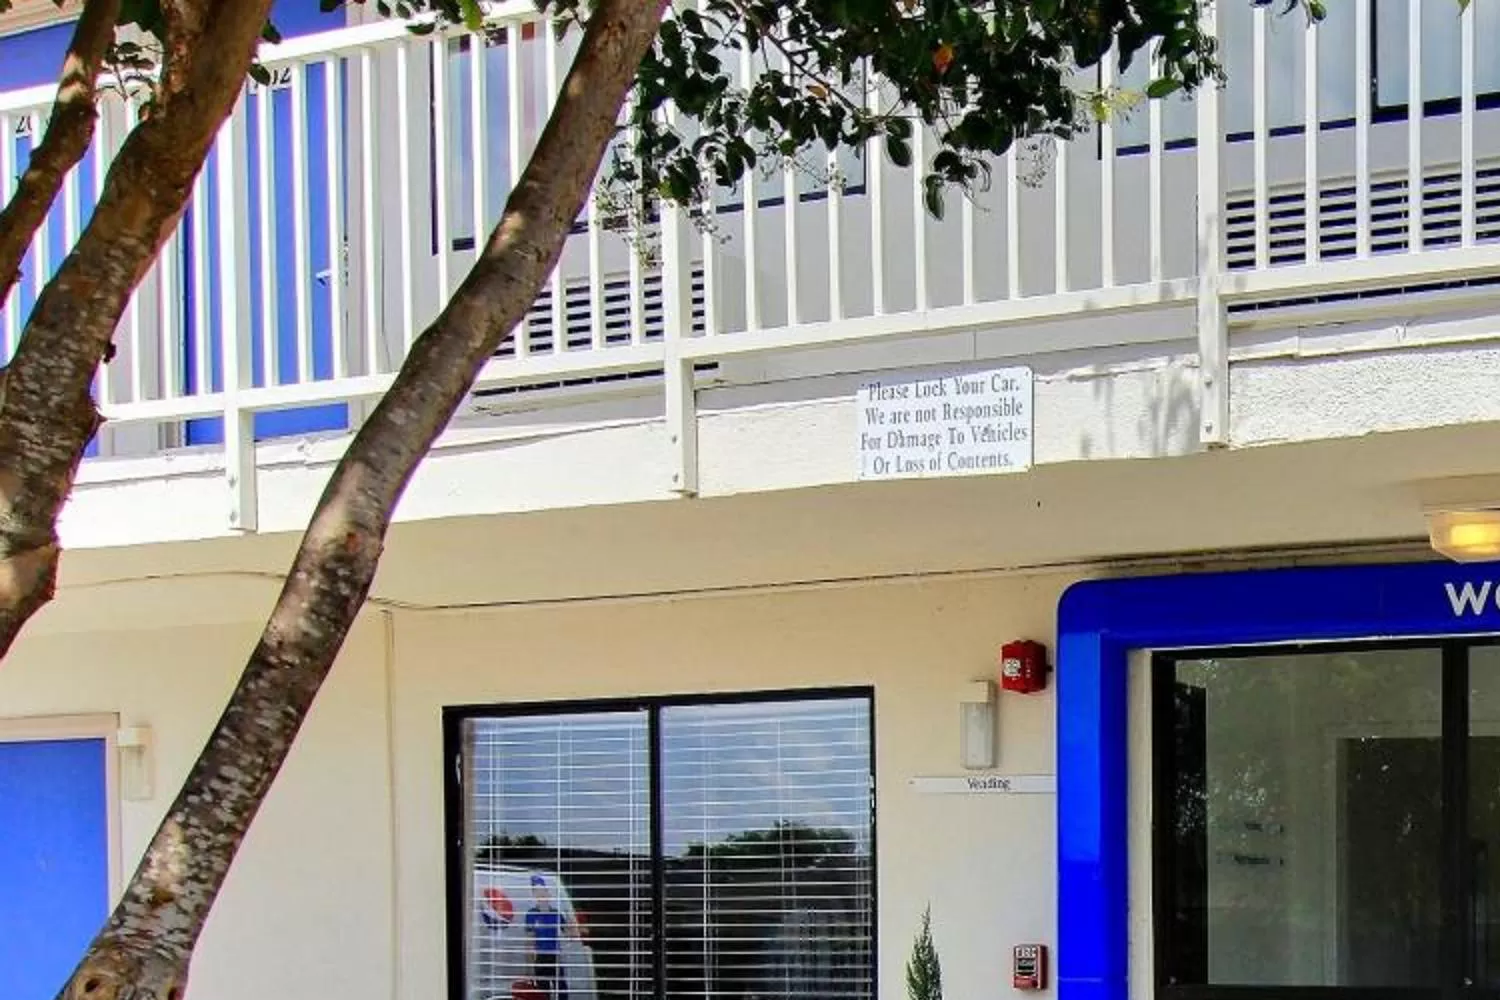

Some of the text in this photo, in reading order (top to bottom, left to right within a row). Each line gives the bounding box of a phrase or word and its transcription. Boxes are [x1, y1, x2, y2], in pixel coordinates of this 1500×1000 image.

[869, 373, 1020, 401] Please Lock Your Car.
[865, 396, 1023, 425] We are not Responsible
[860, 421, 1028, 452] For Damage To Vehicles
[873, 455, 891, 474] Or
[896, 455, 925, 473] Loss
[929, 451, 943, 471] of
